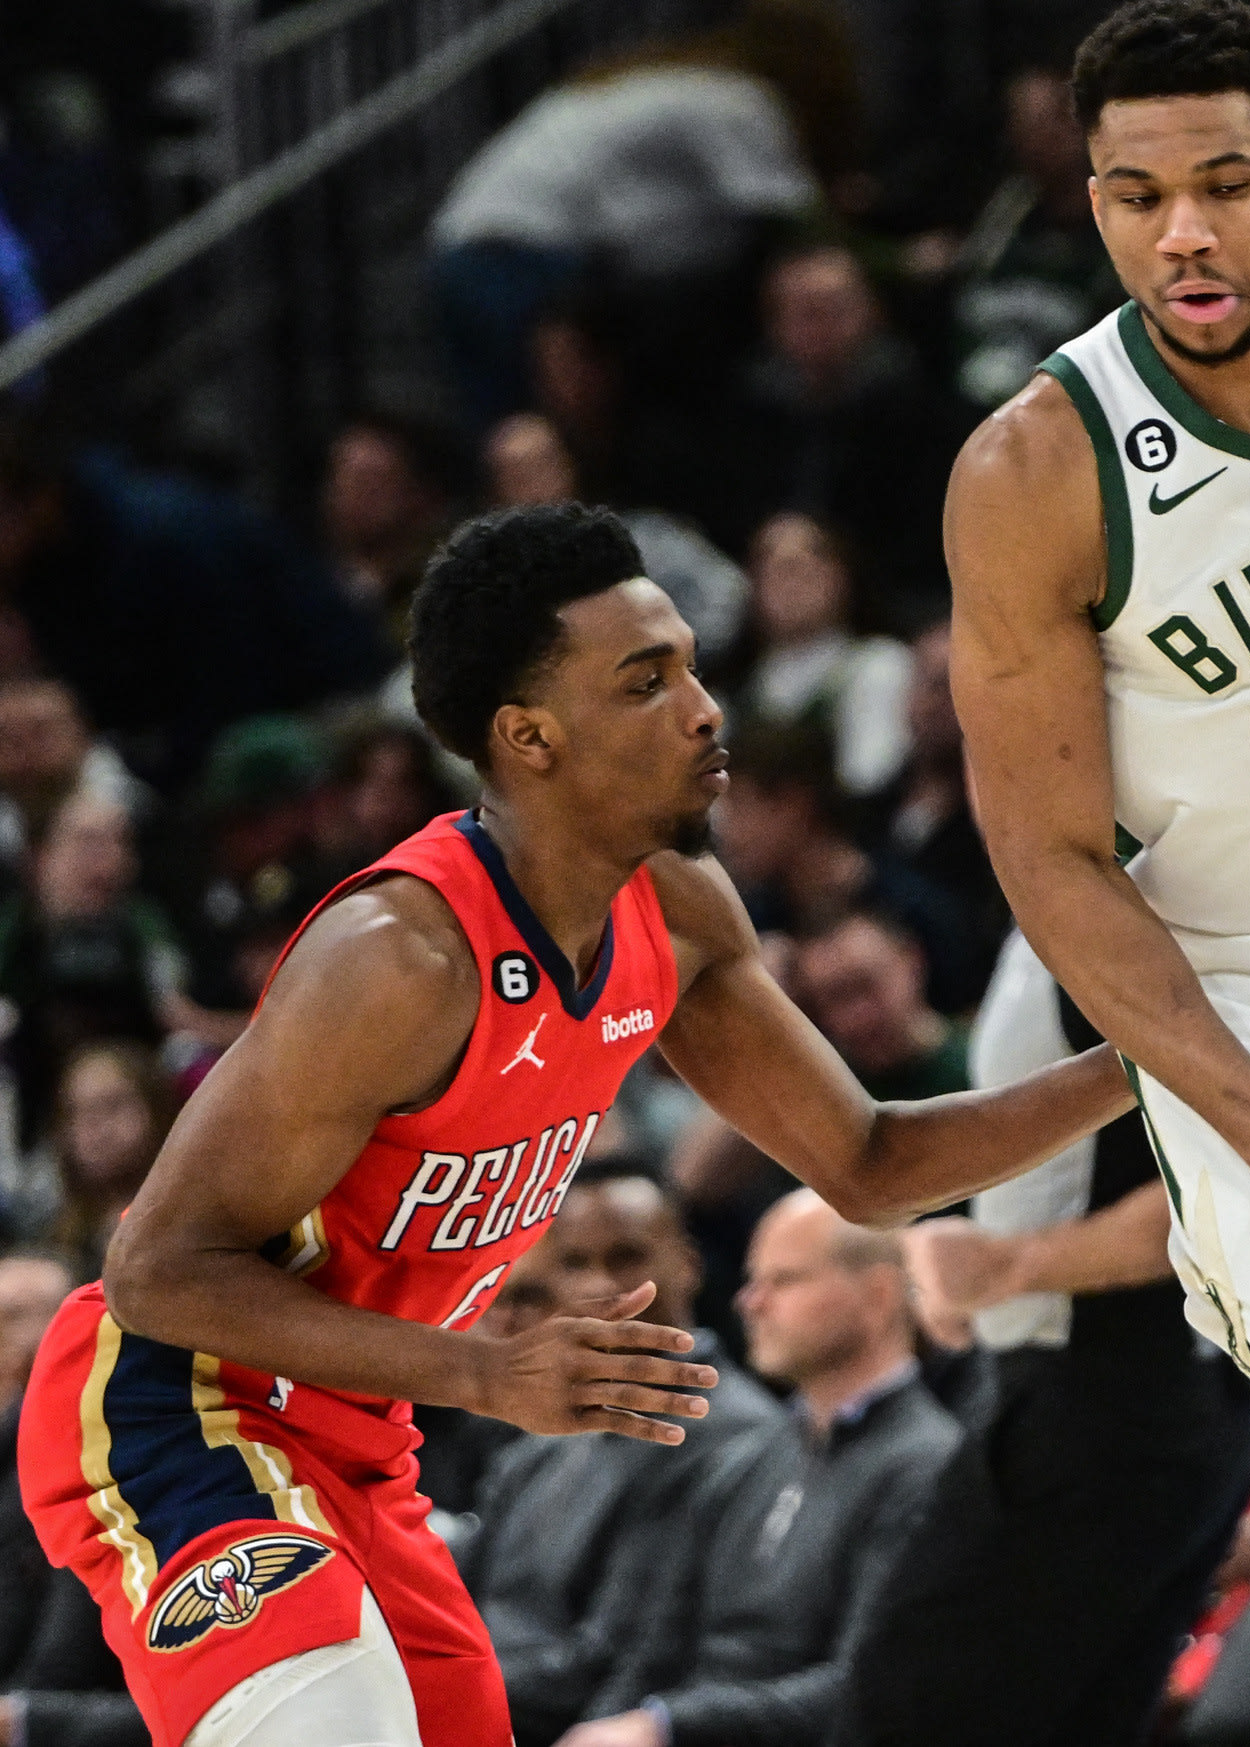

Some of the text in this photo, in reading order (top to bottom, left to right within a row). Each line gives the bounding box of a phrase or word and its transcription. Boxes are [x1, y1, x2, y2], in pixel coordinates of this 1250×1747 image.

[1135, 425, 1169, 468] 6
[499, 958, 530, 999] 6
[601, 1008, 655, 1044] ibotta
